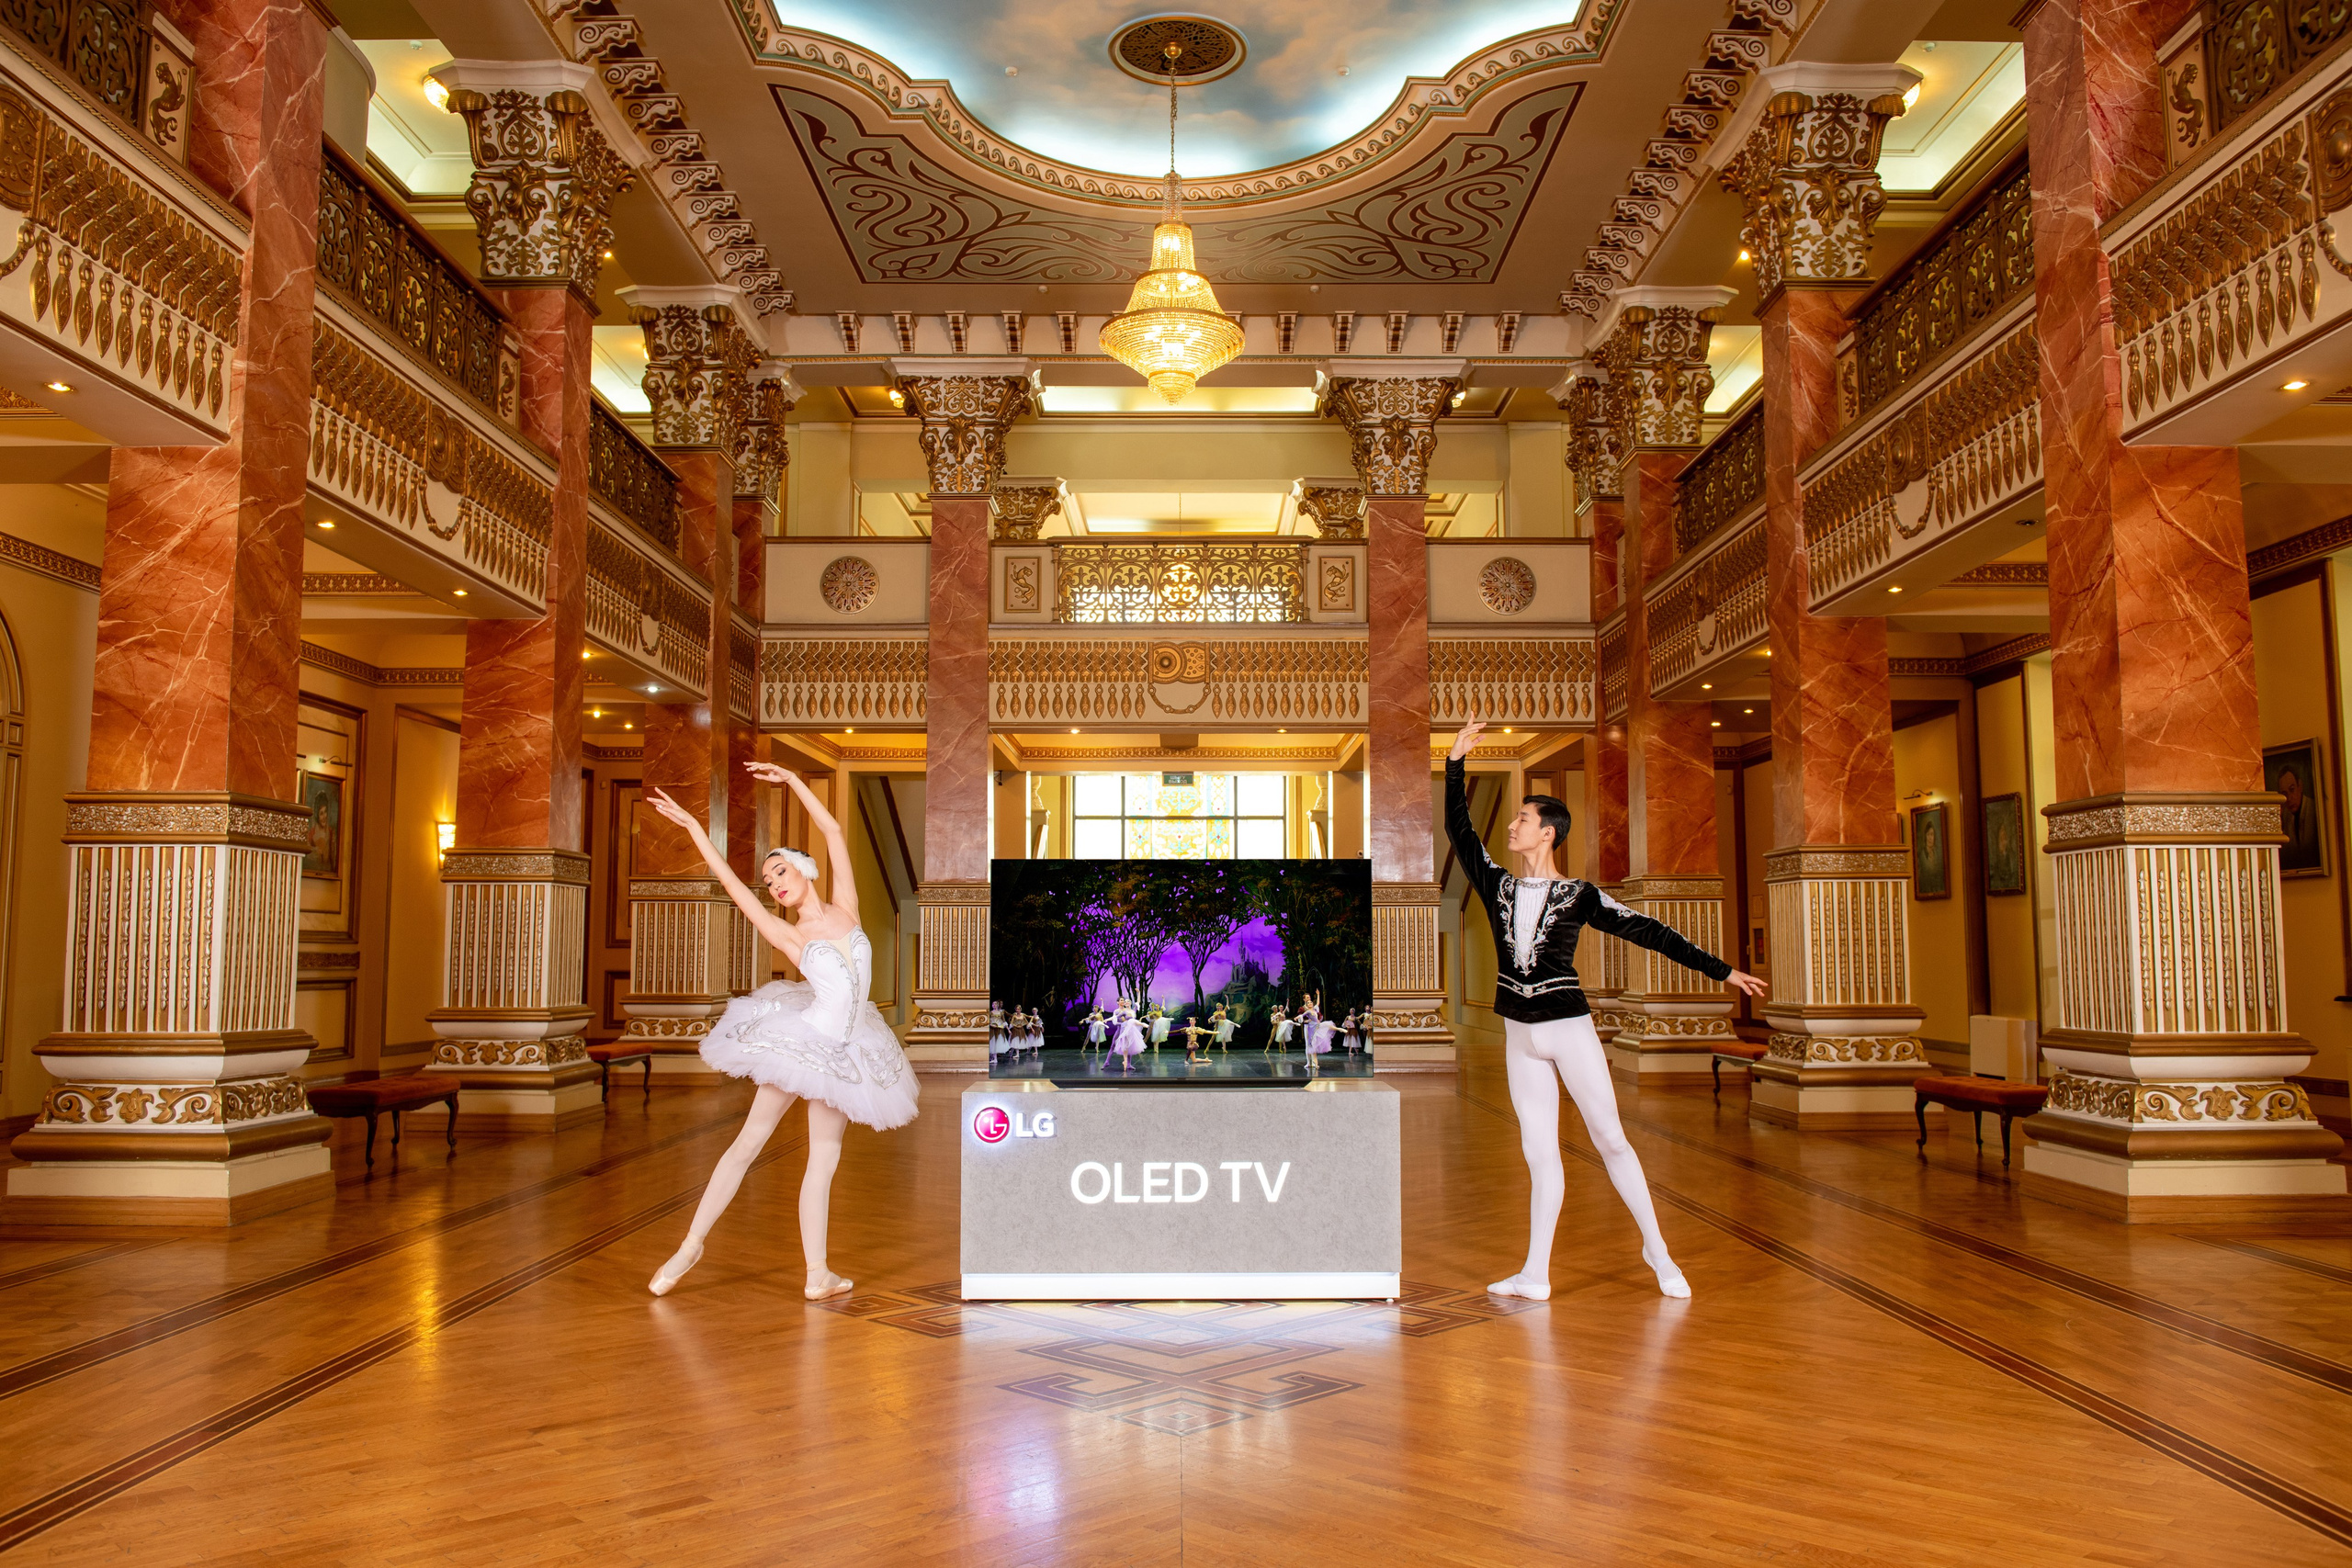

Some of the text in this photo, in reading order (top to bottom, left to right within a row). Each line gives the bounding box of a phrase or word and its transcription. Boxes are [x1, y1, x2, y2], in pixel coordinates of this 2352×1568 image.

[1015, 1112, 1056, 1137] LG
[1070, 1161, 1291, 1204] OLED TV
